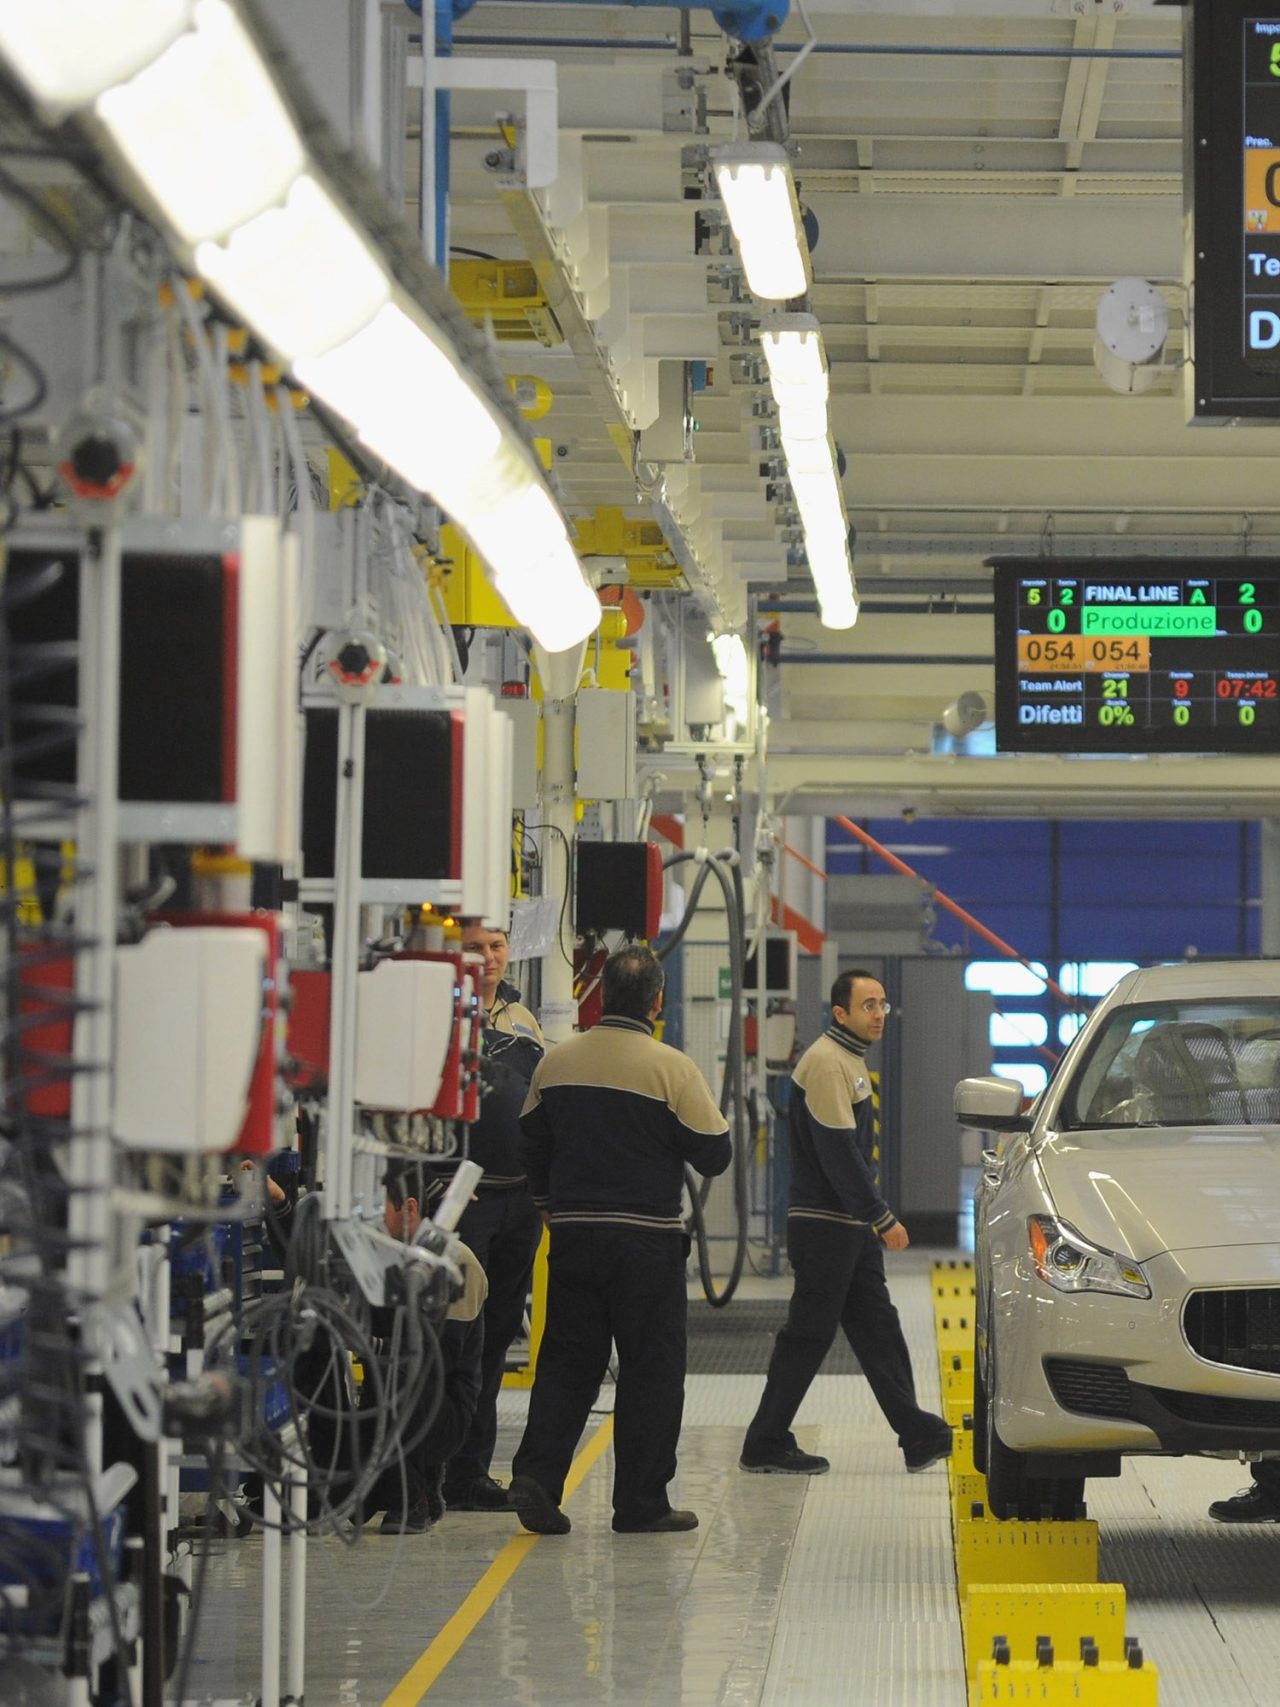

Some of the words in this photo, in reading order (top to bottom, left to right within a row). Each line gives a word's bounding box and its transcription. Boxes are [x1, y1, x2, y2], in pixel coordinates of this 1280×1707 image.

[1245, 136, 1273, 148] Prec.
[1027, 587, 1041, 606] 5
[1060, 587, 1074, 606] 2
[1086, 585, 1137, 601] FINAL
[1139, 585, 1179, 601] LINE
[1189, 588, 1206, 605] A
[1238, 583, 1255, 605] 2
[1046, 608, 1066, 634] 0
[1086, 612, 1213, 630] Produzione
[1243, 608, 1262, 634] 0
[1027, 640, 1075, 661] 054
[1093, 640, 1141, 661] 054
[1020, 680, 1052, 692] Team
[1053, 680, 1083, 692] Alert
[1103, 680, 1128, 698] 21
[1174, 680, 1189, 698] 9
[1217, 680, 1277, 698] 07:42
[1019, 705, 1083, 725] Difetti
[1098, 705, 1135, 726] 0%
[1173, 705, 1190, 726] 0
[1239, 705, 1255, 726] 0
